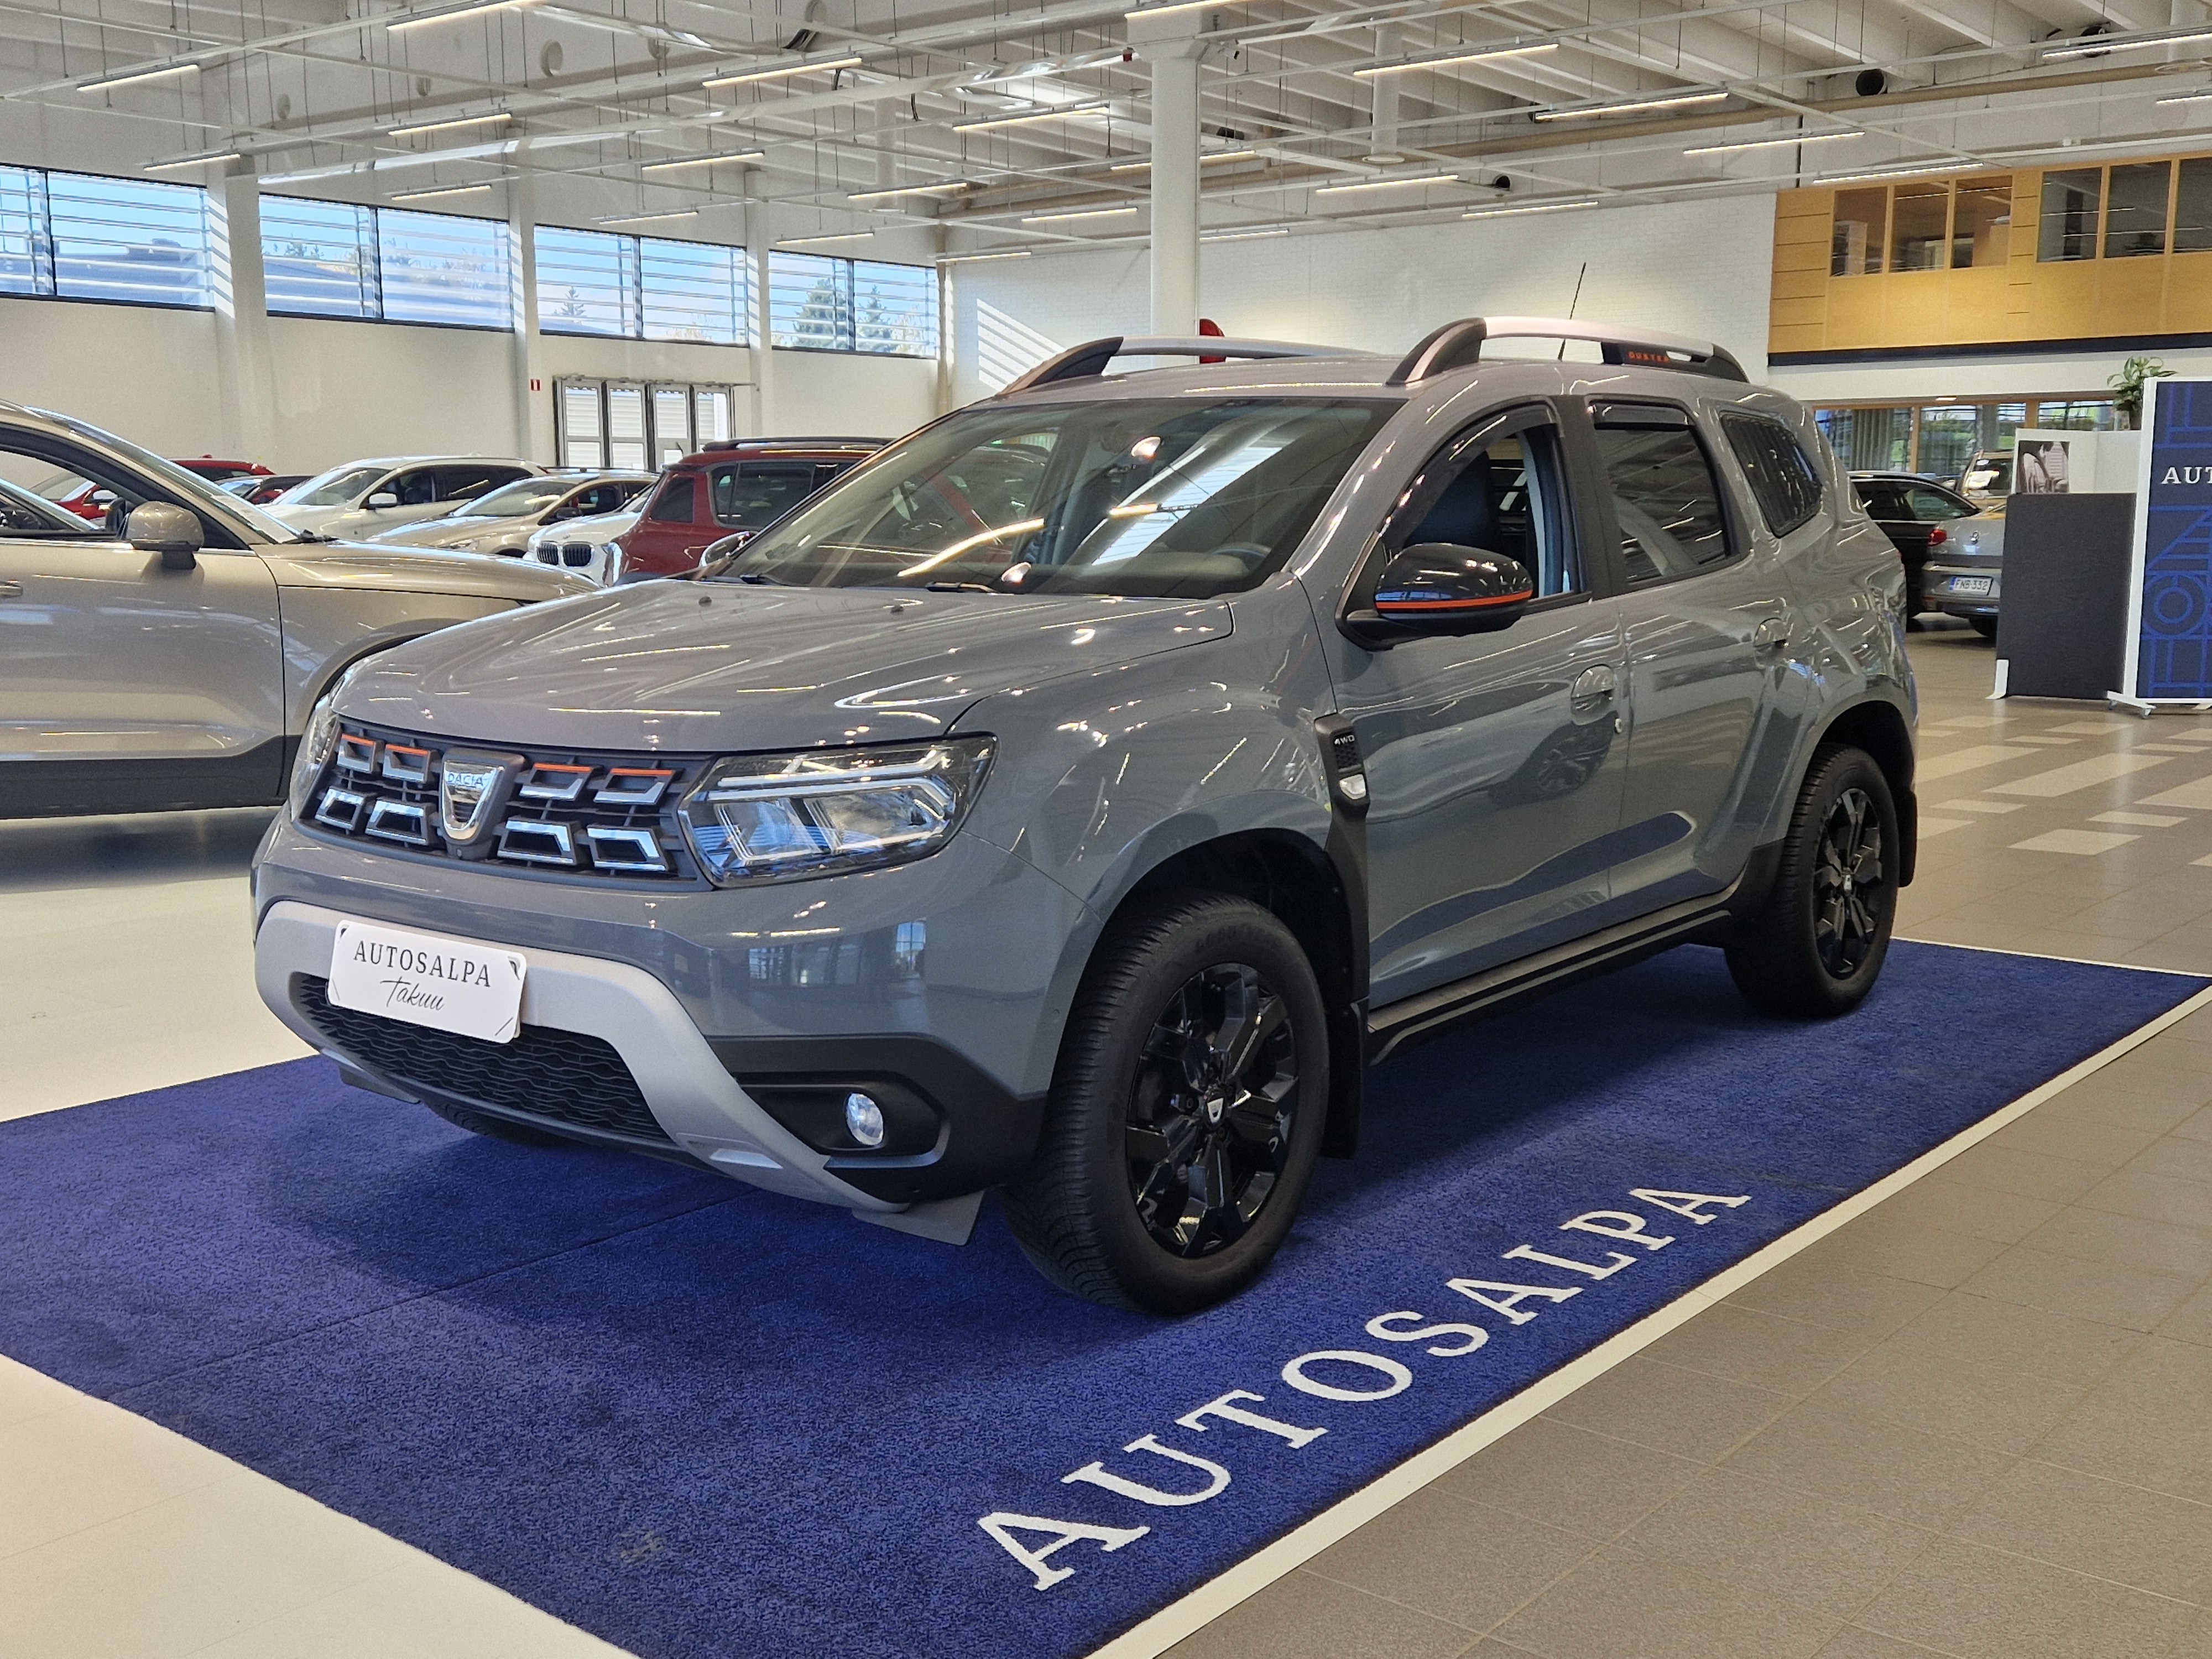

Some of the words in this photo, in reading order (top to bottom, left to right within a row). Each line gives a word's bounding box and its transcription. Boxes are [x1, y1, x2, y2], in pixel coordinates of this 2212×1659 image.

[1334, 734, 1355, 745] 4WD
[447, 773, 483, 786] DACIA
[353, 940, 491, 987] AUTOSALPA
[380, 975, 445, 1011] Takuu
[976, 1187, 1752, 1592] AUTOSALPA
